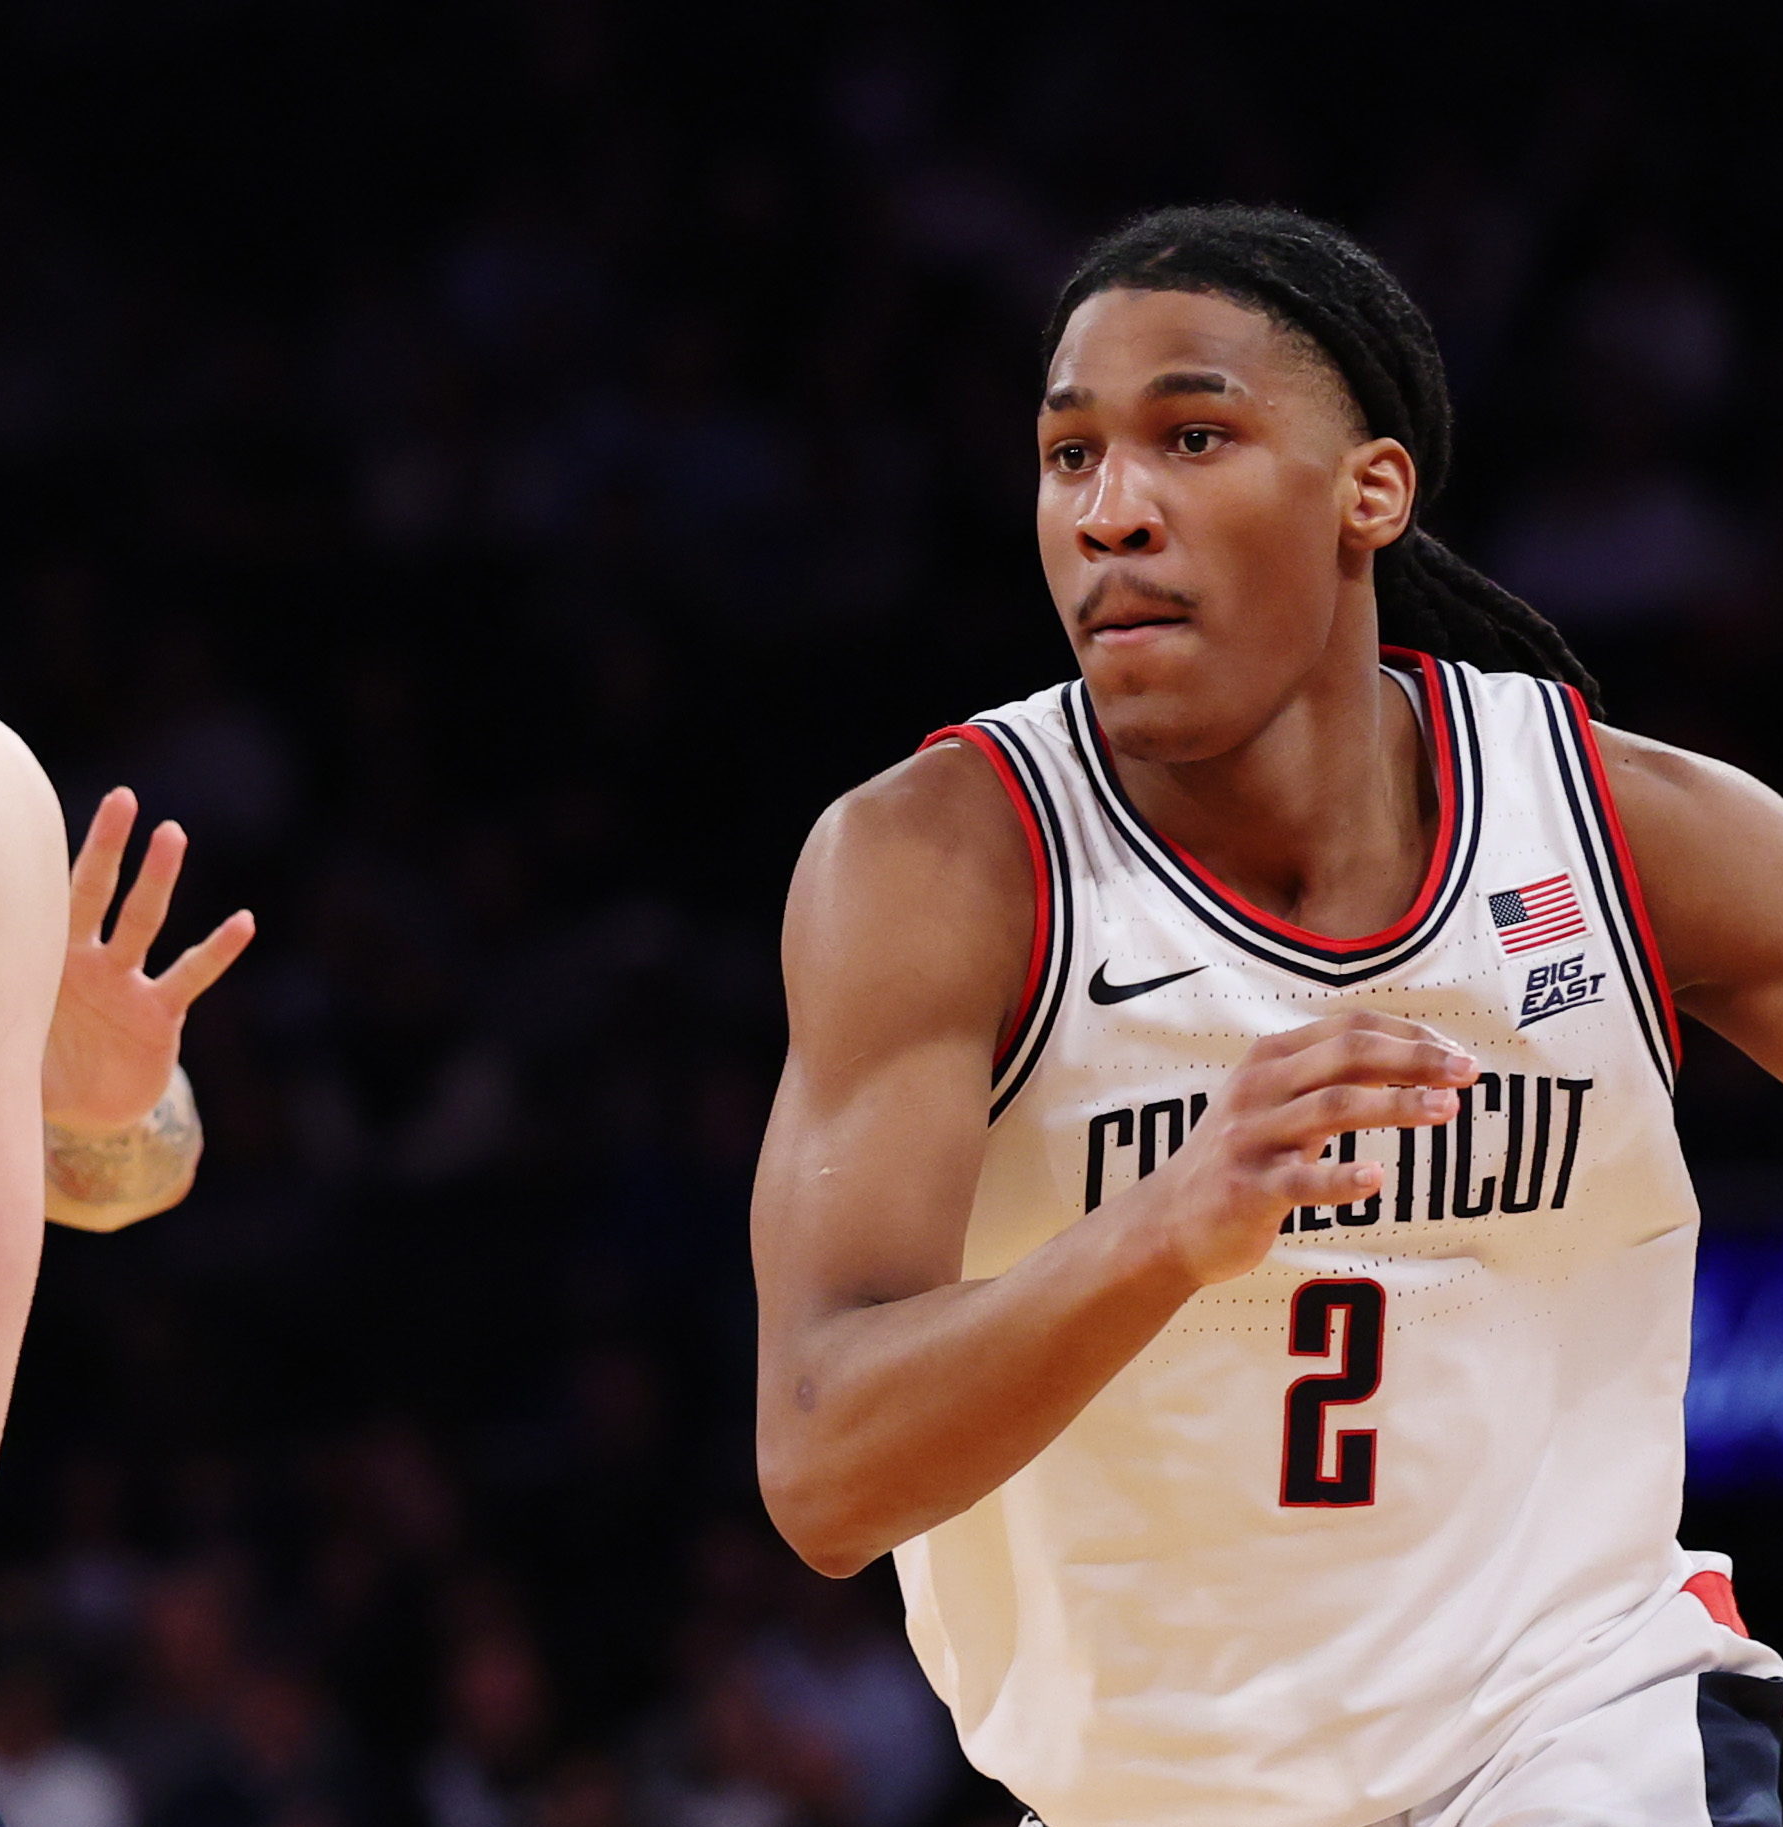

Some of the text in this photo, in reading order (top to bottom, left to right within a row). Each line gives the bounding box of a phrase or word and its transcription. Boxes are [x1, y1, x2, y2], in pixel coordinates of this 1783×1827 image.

[1520, 972, 1607, 1017] EAST
[1525, 951, 1586, 993] BIG
[1279, 1276, 1386, 1508] 2
